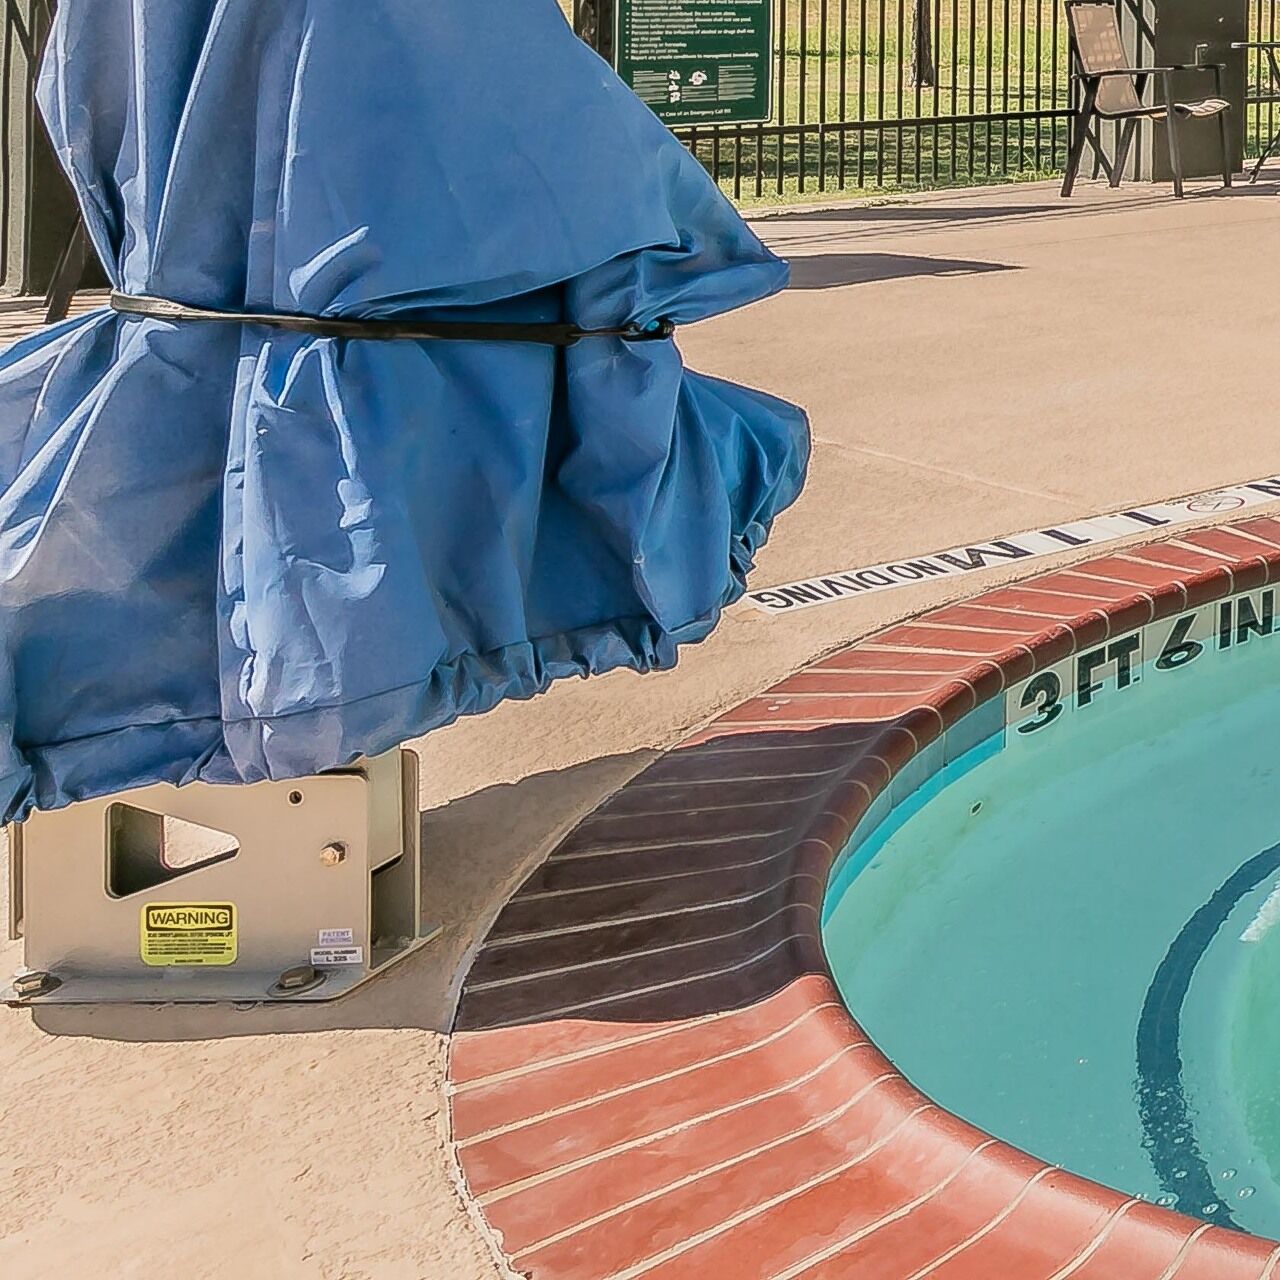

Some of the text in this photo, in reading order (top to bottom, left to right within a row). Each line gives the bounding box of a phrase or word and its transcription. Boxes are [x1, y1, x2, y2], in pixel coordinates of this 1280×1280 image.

[885, 559, 948, 580] NO
[934, 541, 1036, 571] M
[748, 570, 900, 609] DIVING
[1017, 671, 1064, 734] 3
[1076, 631, 1141, 708] FT.
[1153, 612, 1204, 671] 6
[151, 912, 229, 924] WARNING
